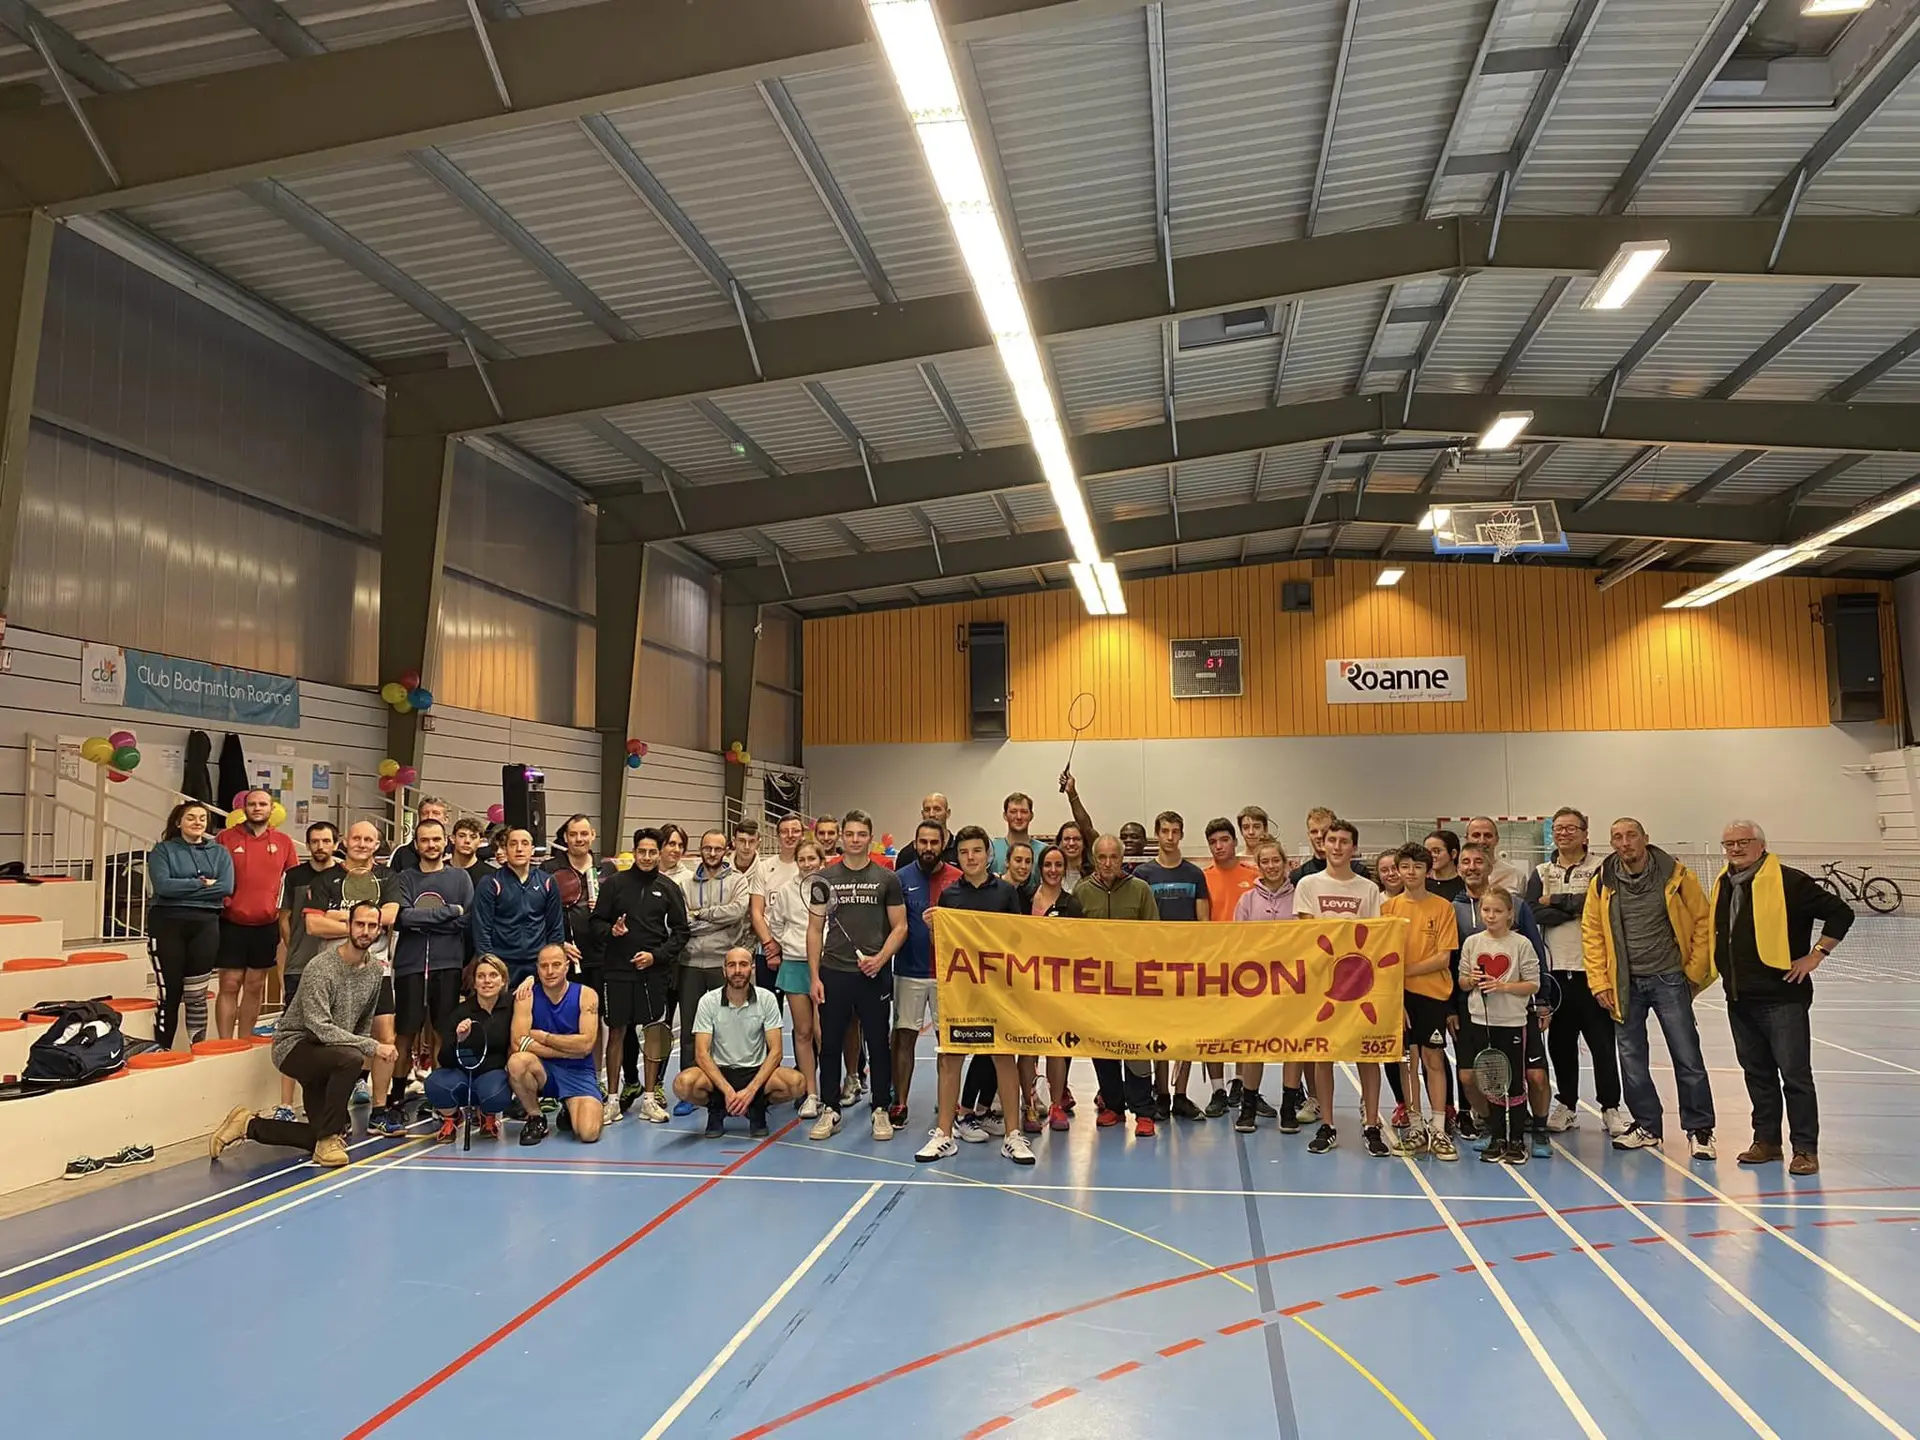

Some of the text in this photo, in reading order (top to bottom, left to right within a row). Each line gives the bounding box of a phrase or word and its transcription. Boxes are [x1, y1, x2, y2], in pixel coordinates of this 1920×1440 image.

[137, 665, 292, 706] Club Badminton Roanne
[1347, 663, 1449, 691] Roanne
[1005, 1032, 1053, 1044] Carrefour
[1360, 1039, 1397, 1054] 3637
